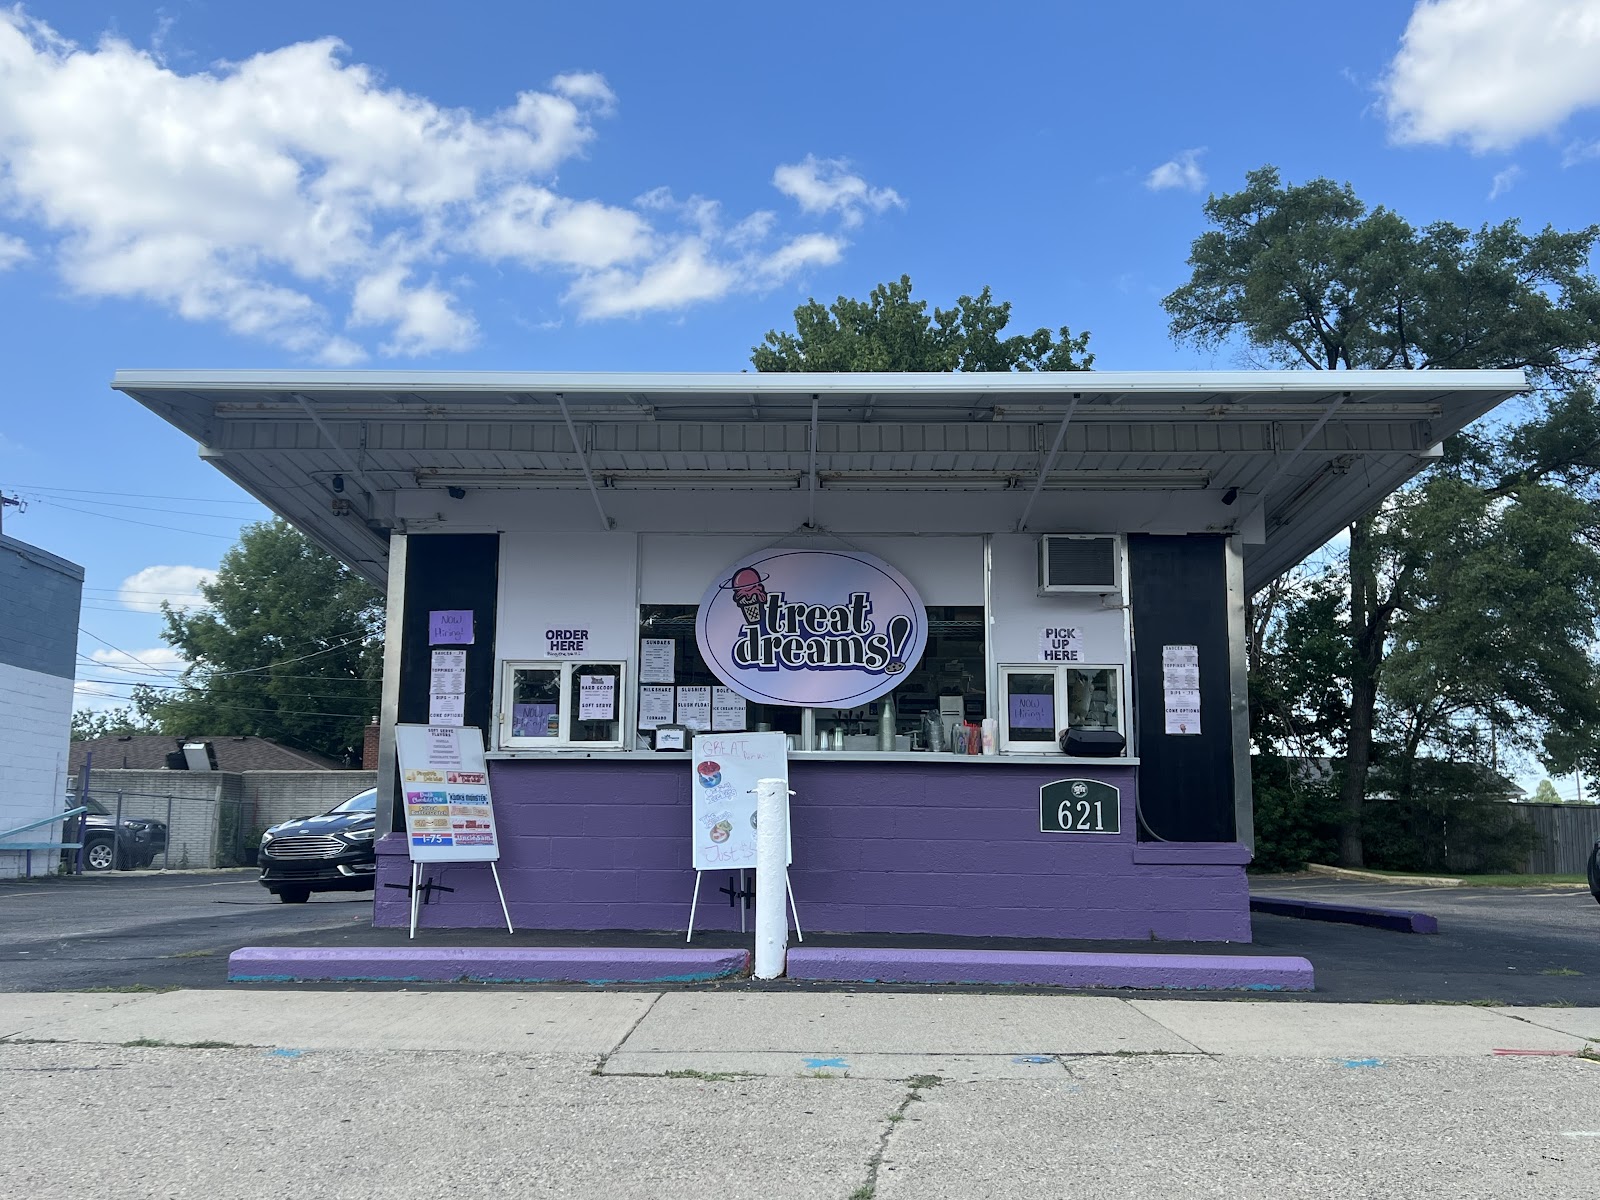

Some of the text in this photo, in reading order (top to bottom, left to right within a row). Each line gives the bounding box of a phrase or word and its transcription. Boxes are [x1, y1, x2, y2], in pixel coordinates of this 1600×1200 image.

[763, 591, 875, 637] treat
[434, 628, 464, 640] Hiring!
[545, 629, 589, 640] ORDER
[1046, 628, 1076, 639] PICK
[550, 640, 584, 651] HERE
[732, 615, 912, 676] dreams!
[1052, 639, 1070, 650] UP
[1044, 650, 1078, 660] HERE
[1020, 699, 1040, 708] NOW
[523, 707, 543, 717] NOW
[1014, 708, 1044, 720] Hiring!
[702, 740, 749, 757] GREAT
[1058, 800, 1104, 830] 621
[704, 845, 740, 862] Just
